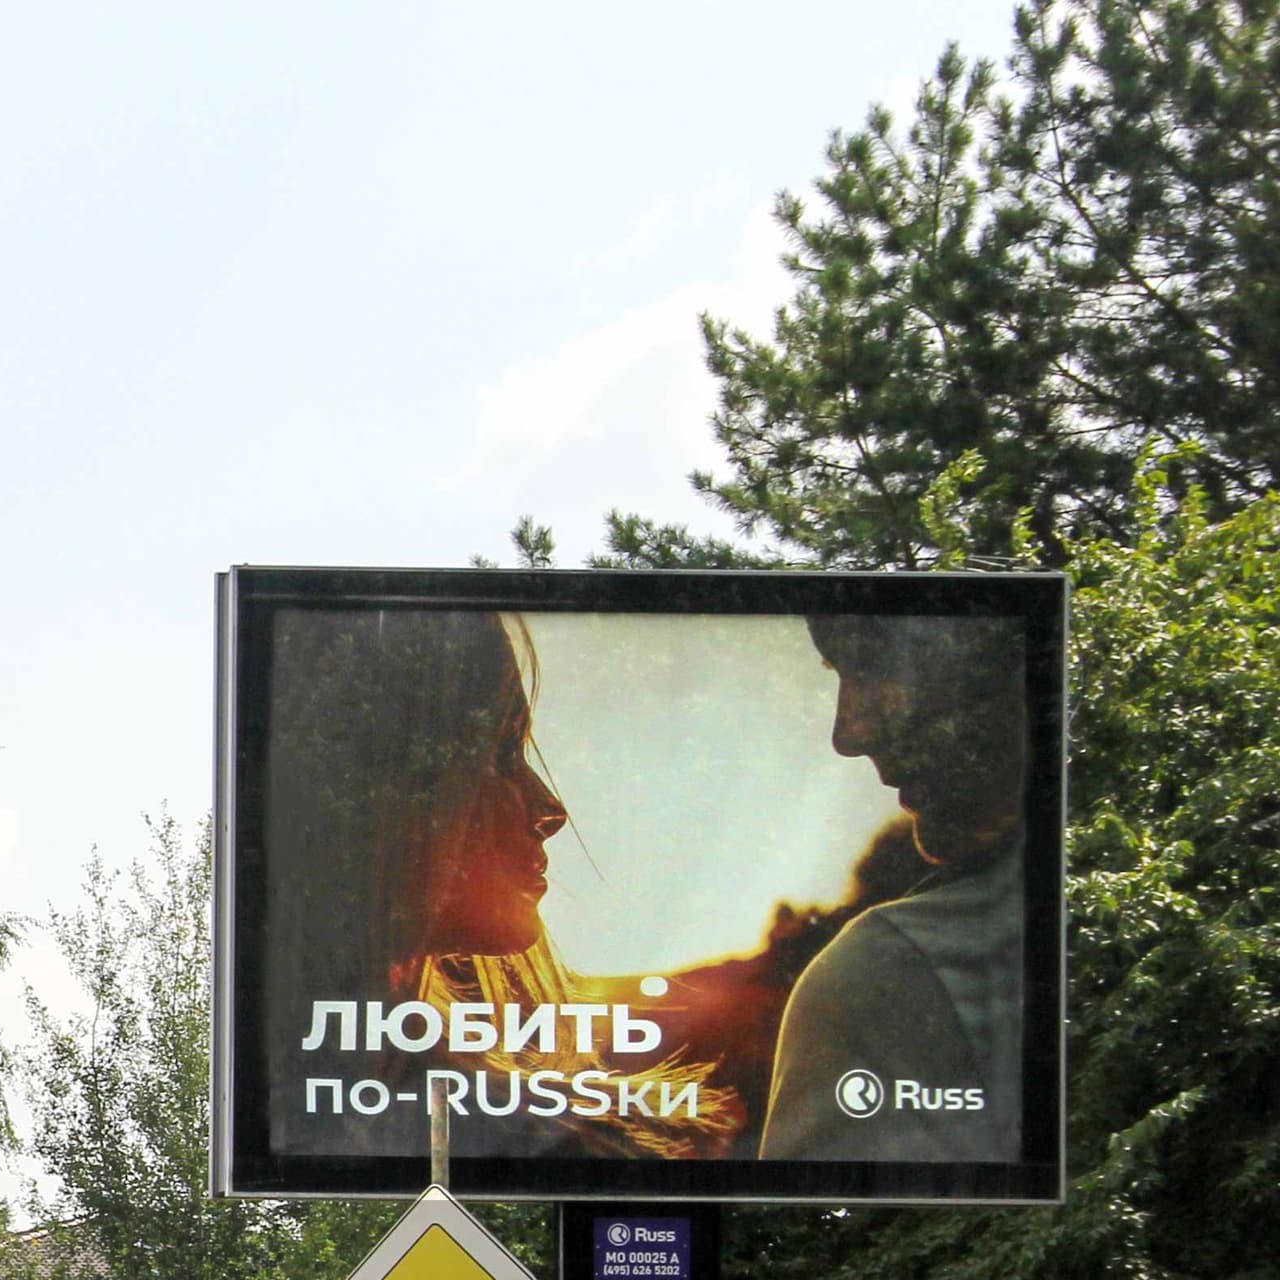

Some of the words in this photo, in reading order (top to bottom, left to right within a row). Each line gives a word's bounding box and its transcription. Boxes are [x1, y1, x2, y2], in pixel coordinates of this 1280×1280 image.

[301, 1000, 662, 1054] ЛЮБИТЬ
[895, 1079, 985, 1111] Russ
[634, 1227, 676, 1242] Russ
[605, 1251, 626, 1264] МО
[629, 1251, 667, 1264] 00025
[670, 1252, 680, 1264] А
[603, 1264, 630, 1276] (495)
[632, 1265, 652, 1275] 626
[654, 1265, 680, 1275] 5202
